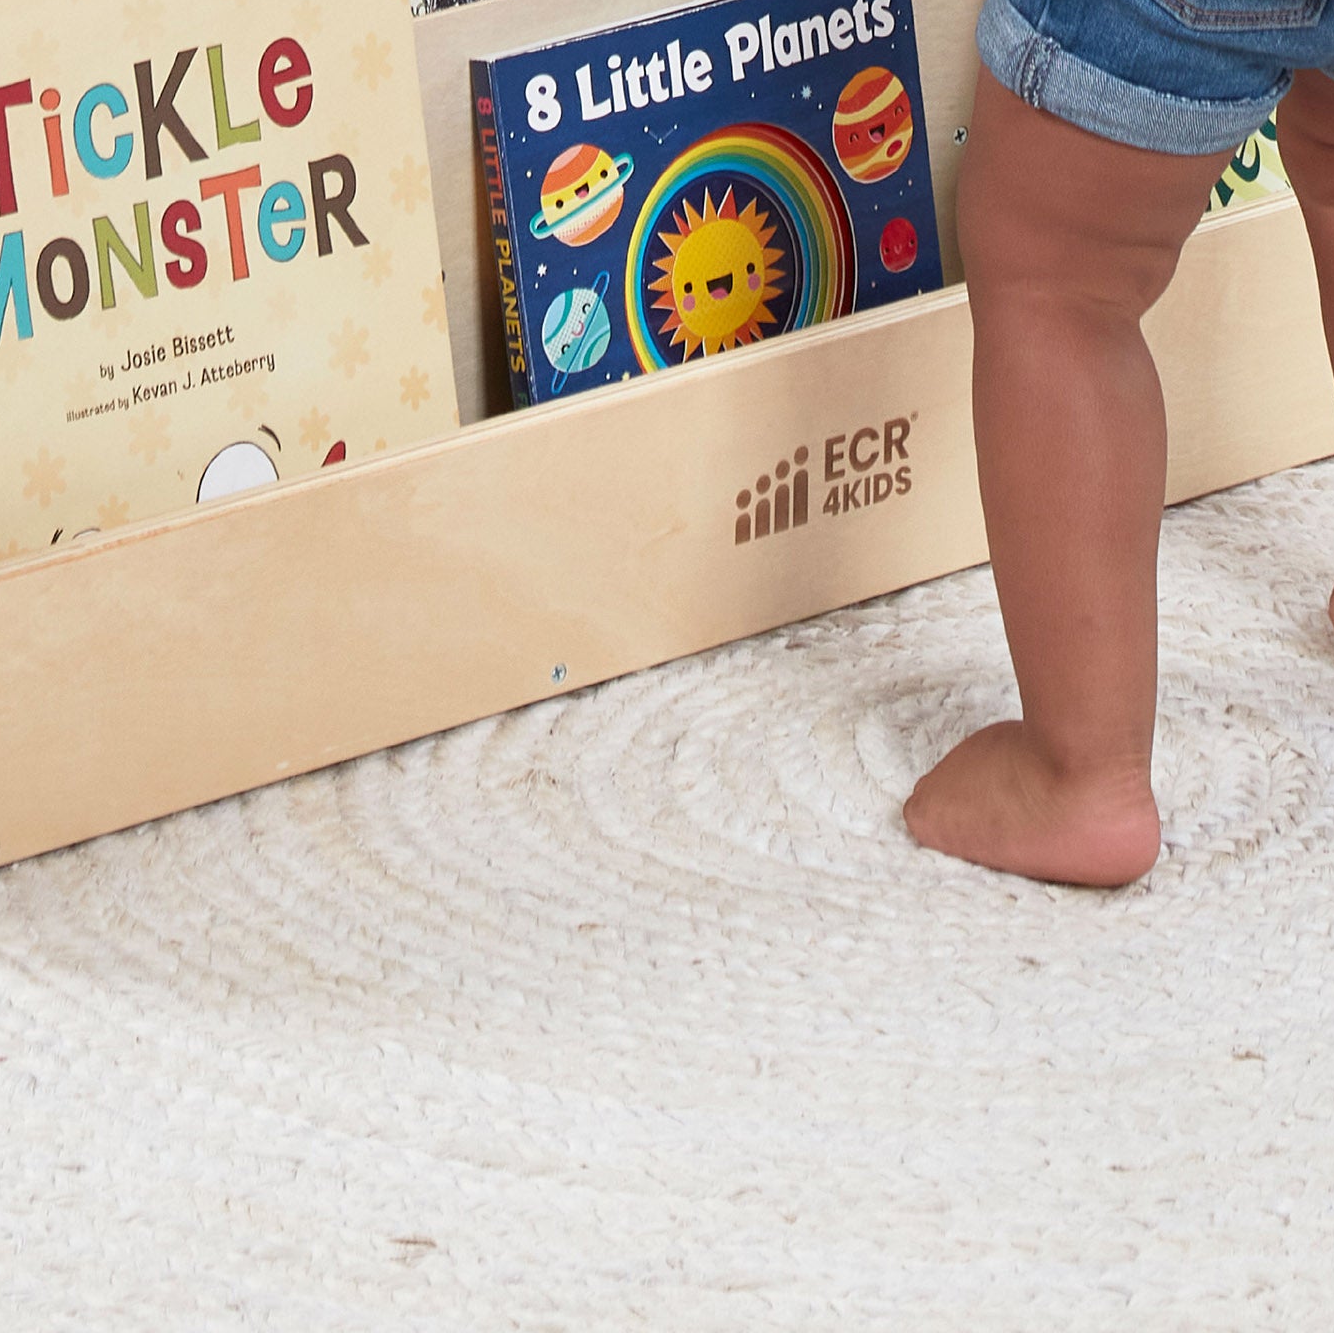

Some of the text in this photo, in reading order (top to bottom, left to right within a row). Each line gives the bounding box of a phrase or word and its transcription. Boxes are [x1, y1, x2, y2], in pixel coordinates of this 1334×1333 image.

[477, 97, 492, 116] 8
[523, 73, 563, 132] 8
[575, 38, 714, 122] Little
[481, 128, 508, 226] LITTLE
[495, 238, 526, 374] PLANETS
[99, 324, 235, 381] by Josie Bissett
[117, 395, 130, 410] by
[132, 380, 178, 405] Kevan
[183, 370, 196, 391] J.
[200, 352, 276, 388] Atteberry
[822, 465, 912, 517] 4KIDS
